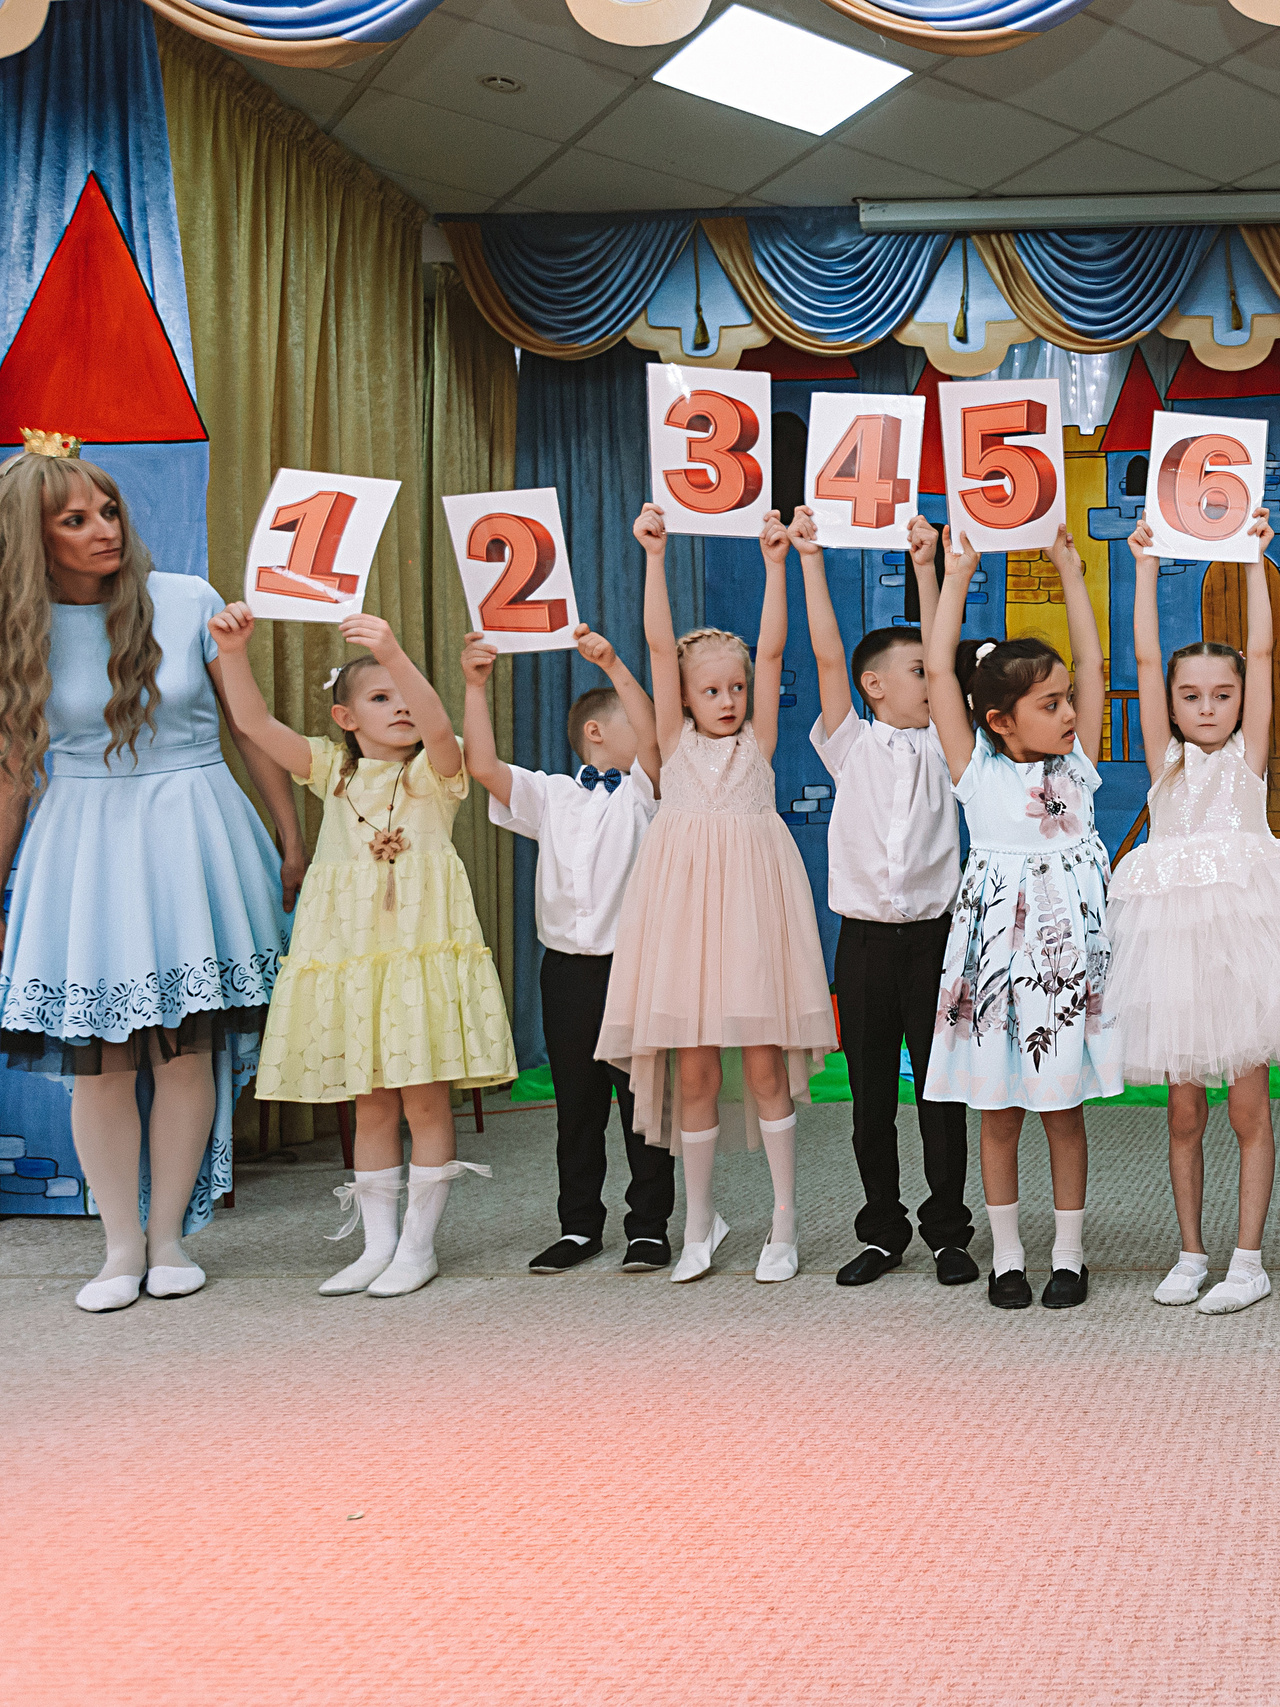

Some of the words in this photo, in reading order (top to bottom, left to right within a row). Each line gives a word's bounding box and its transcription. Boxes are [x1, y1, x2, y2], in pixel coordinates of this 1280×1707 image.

[662, 389, 763, 514] 3
[814, 413, 911, 529] 4
[958, 399, 1058, 530] 5
[1157, 433, 1253, 541] 6
[255, 490, 359, 604] 1
[466, 512, 568, 633] 2
